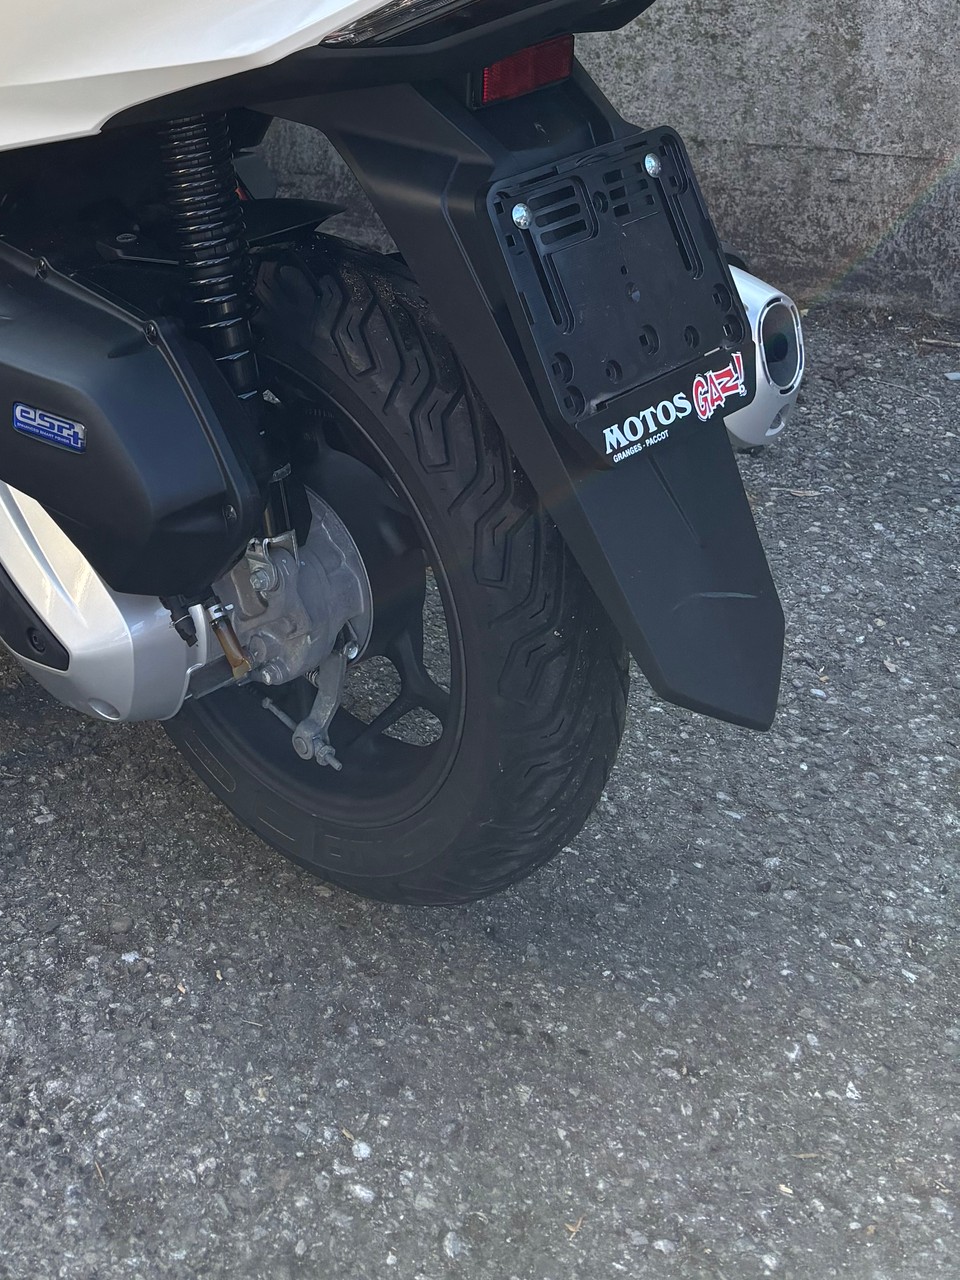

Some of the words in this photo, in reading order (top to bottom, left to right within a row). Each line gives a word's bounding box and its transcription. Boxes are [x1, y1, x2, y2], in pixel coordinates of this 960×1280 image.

[602, 391, 692, 454] MOTOS
[692, 352, 747, 422] GAZ!
[612, 443, 642, 463] GRANGES
[645, 429, 669, 447] PACCOT
